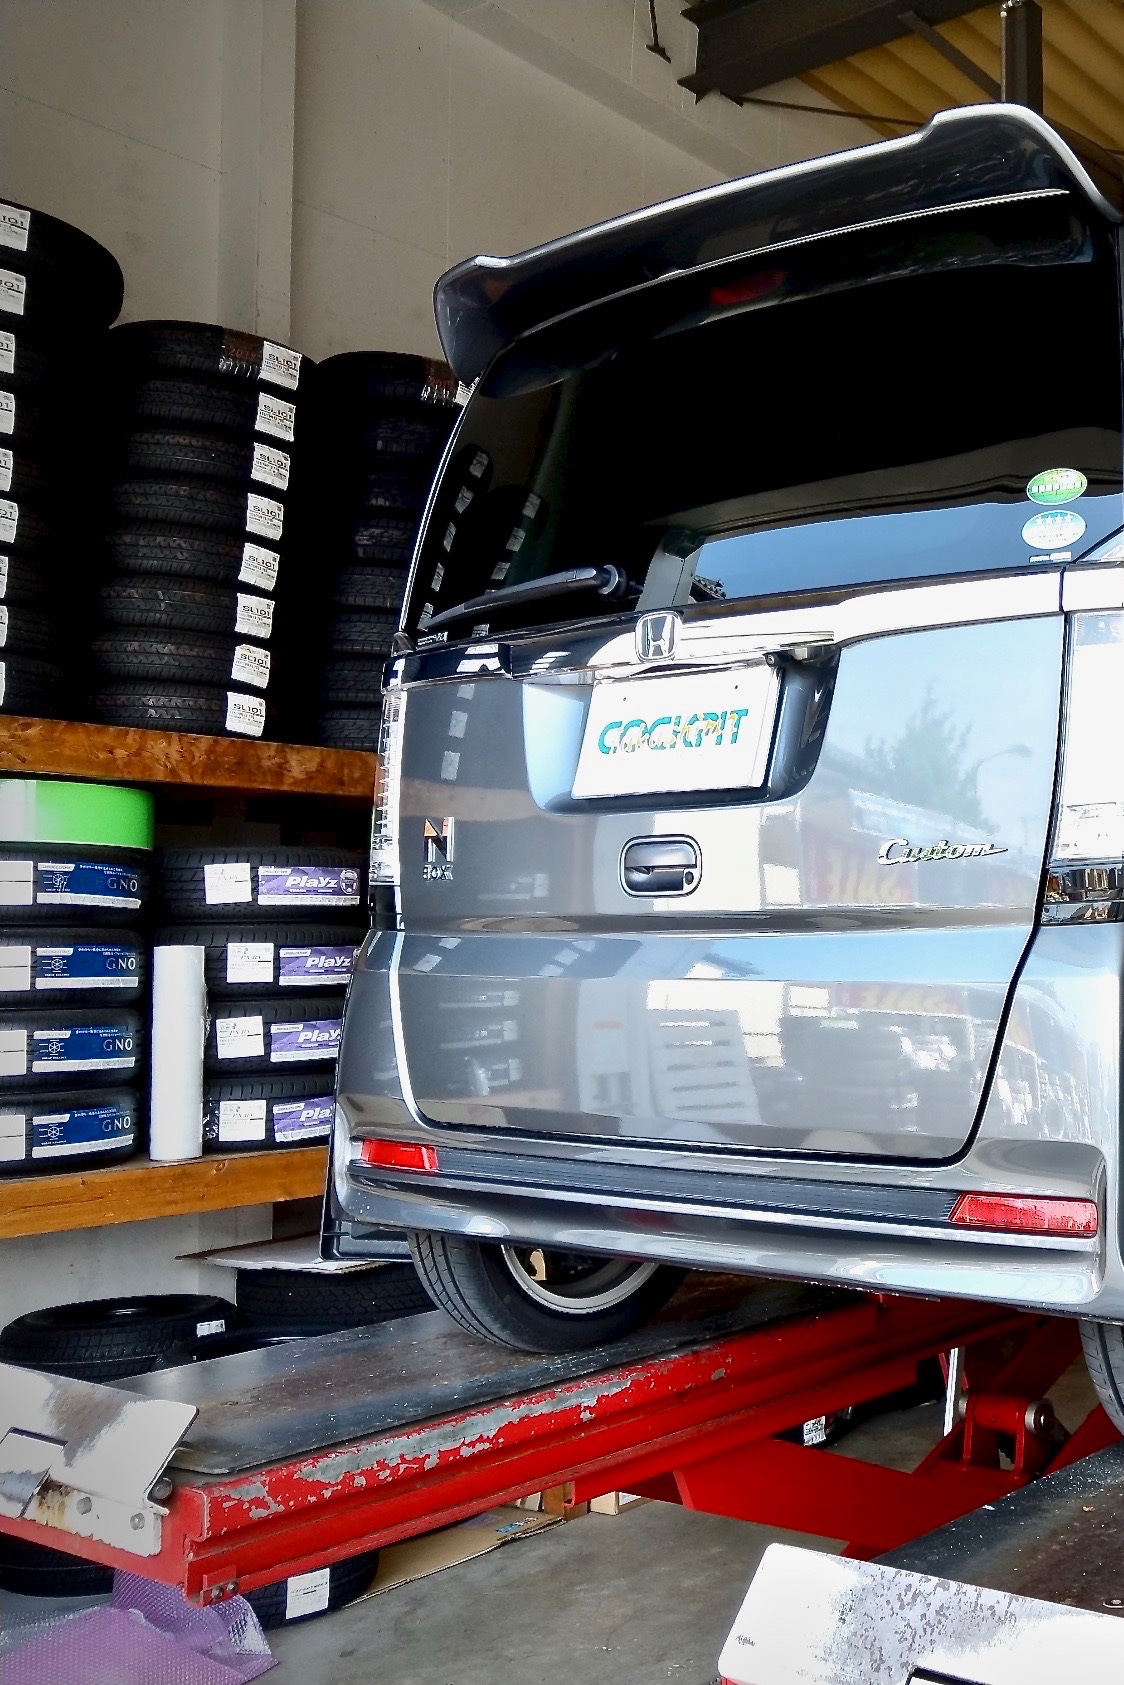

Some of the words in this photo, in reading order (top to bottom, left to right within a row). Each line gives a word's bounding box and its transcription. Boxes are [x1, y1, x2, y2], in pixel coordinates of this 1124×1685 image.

[248, 555, 276, 569] SL101
[242, 605, 270, 617] SL101
[240, 653, 268, 666] SL101
[233, 703, 262, 715] SL101
[597, 708, 749, 755] COCKPIT
[877, 838, 1009, 866] Custom
[284, 875, 339, 888] Playz
[304, 955, 351, 968] Playz
[297, 1028, 341, 1043] Play
[299, 1106, 333, 1122] Pla
